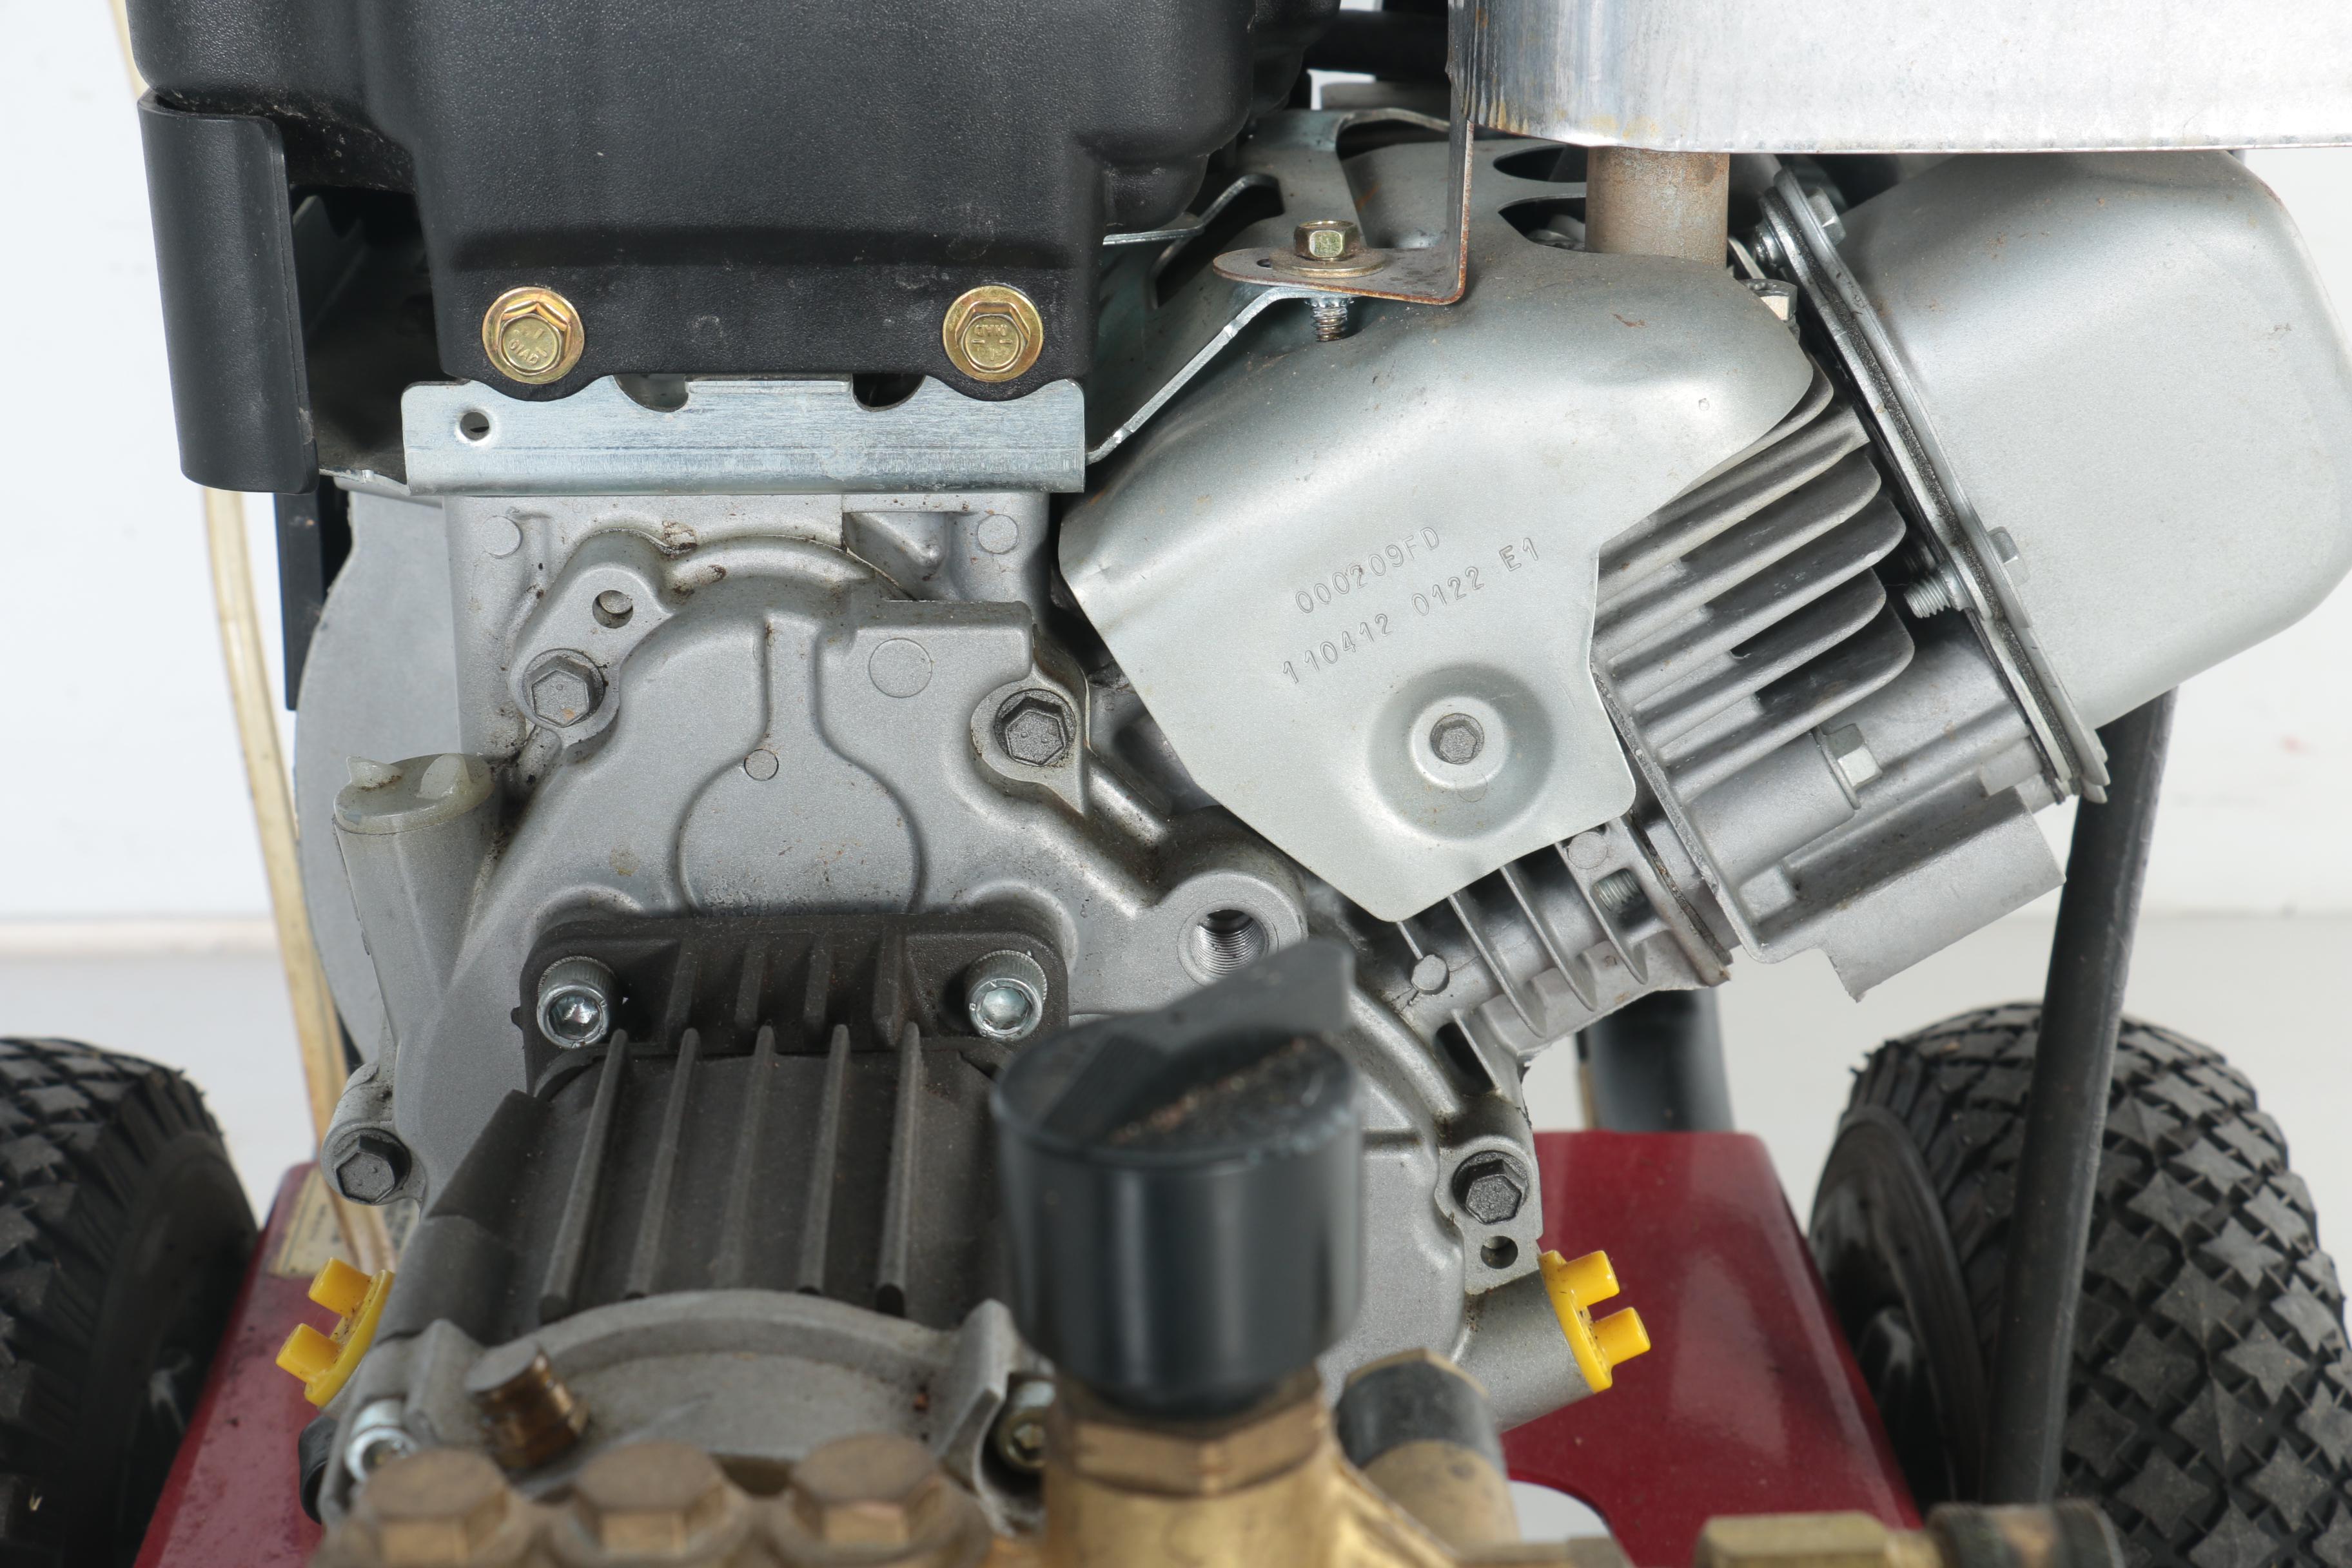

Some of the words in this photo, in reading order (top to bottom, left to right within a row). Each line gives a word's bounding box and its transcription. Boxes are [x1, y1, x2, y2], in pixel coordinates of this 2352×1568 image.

[1282, 613, 1392, 684] 110412
[1411, 566, 1484, 616] 0122
[1498, 538, 1539, 572] E1
[1295, 527, 1440, 614] 000209FD
